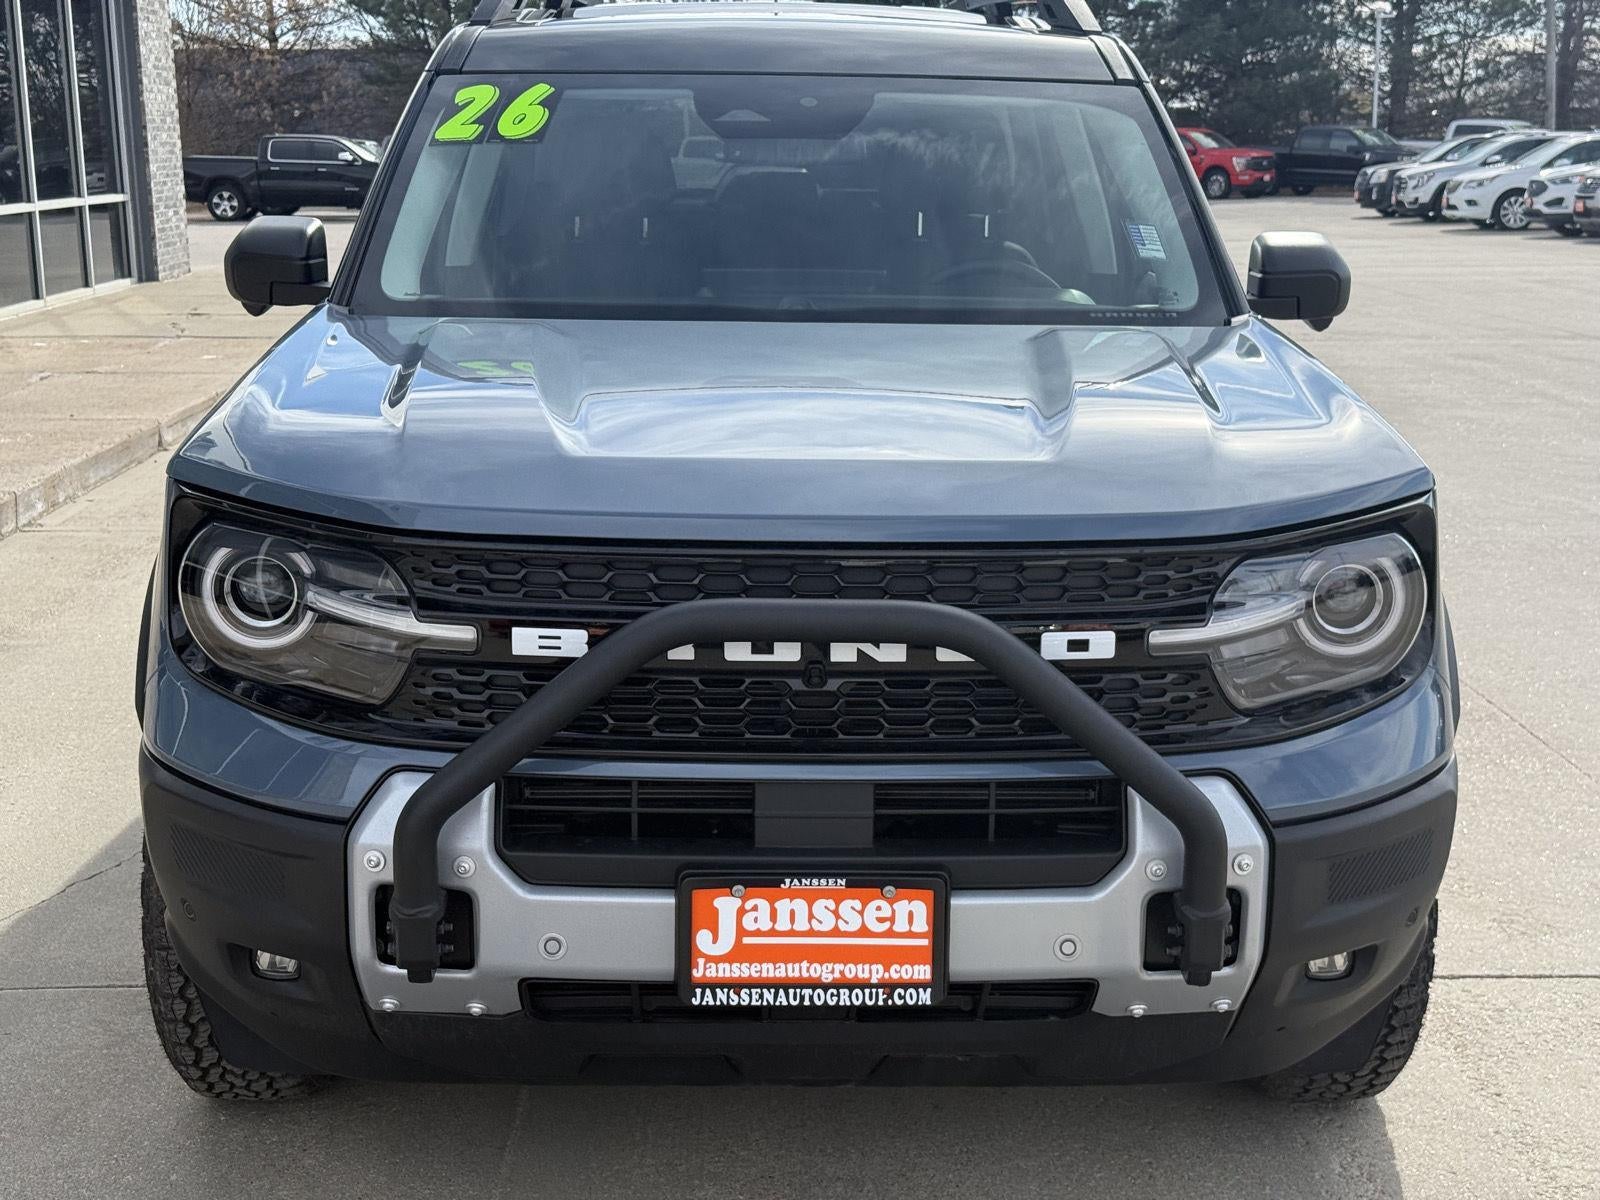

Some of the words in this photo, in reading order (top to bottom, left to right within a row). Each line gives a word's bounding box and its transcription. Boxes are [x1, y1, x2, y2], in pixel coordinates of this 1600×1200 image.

[434, 82, 556, 142] 26
[511, 626, 1116, 662] BONO
[780, 878, 847, 889] JANSSEN
[696, 896, 929, 956] Janssen
[692, 957, 932, 983] Janssenautogroup.com
